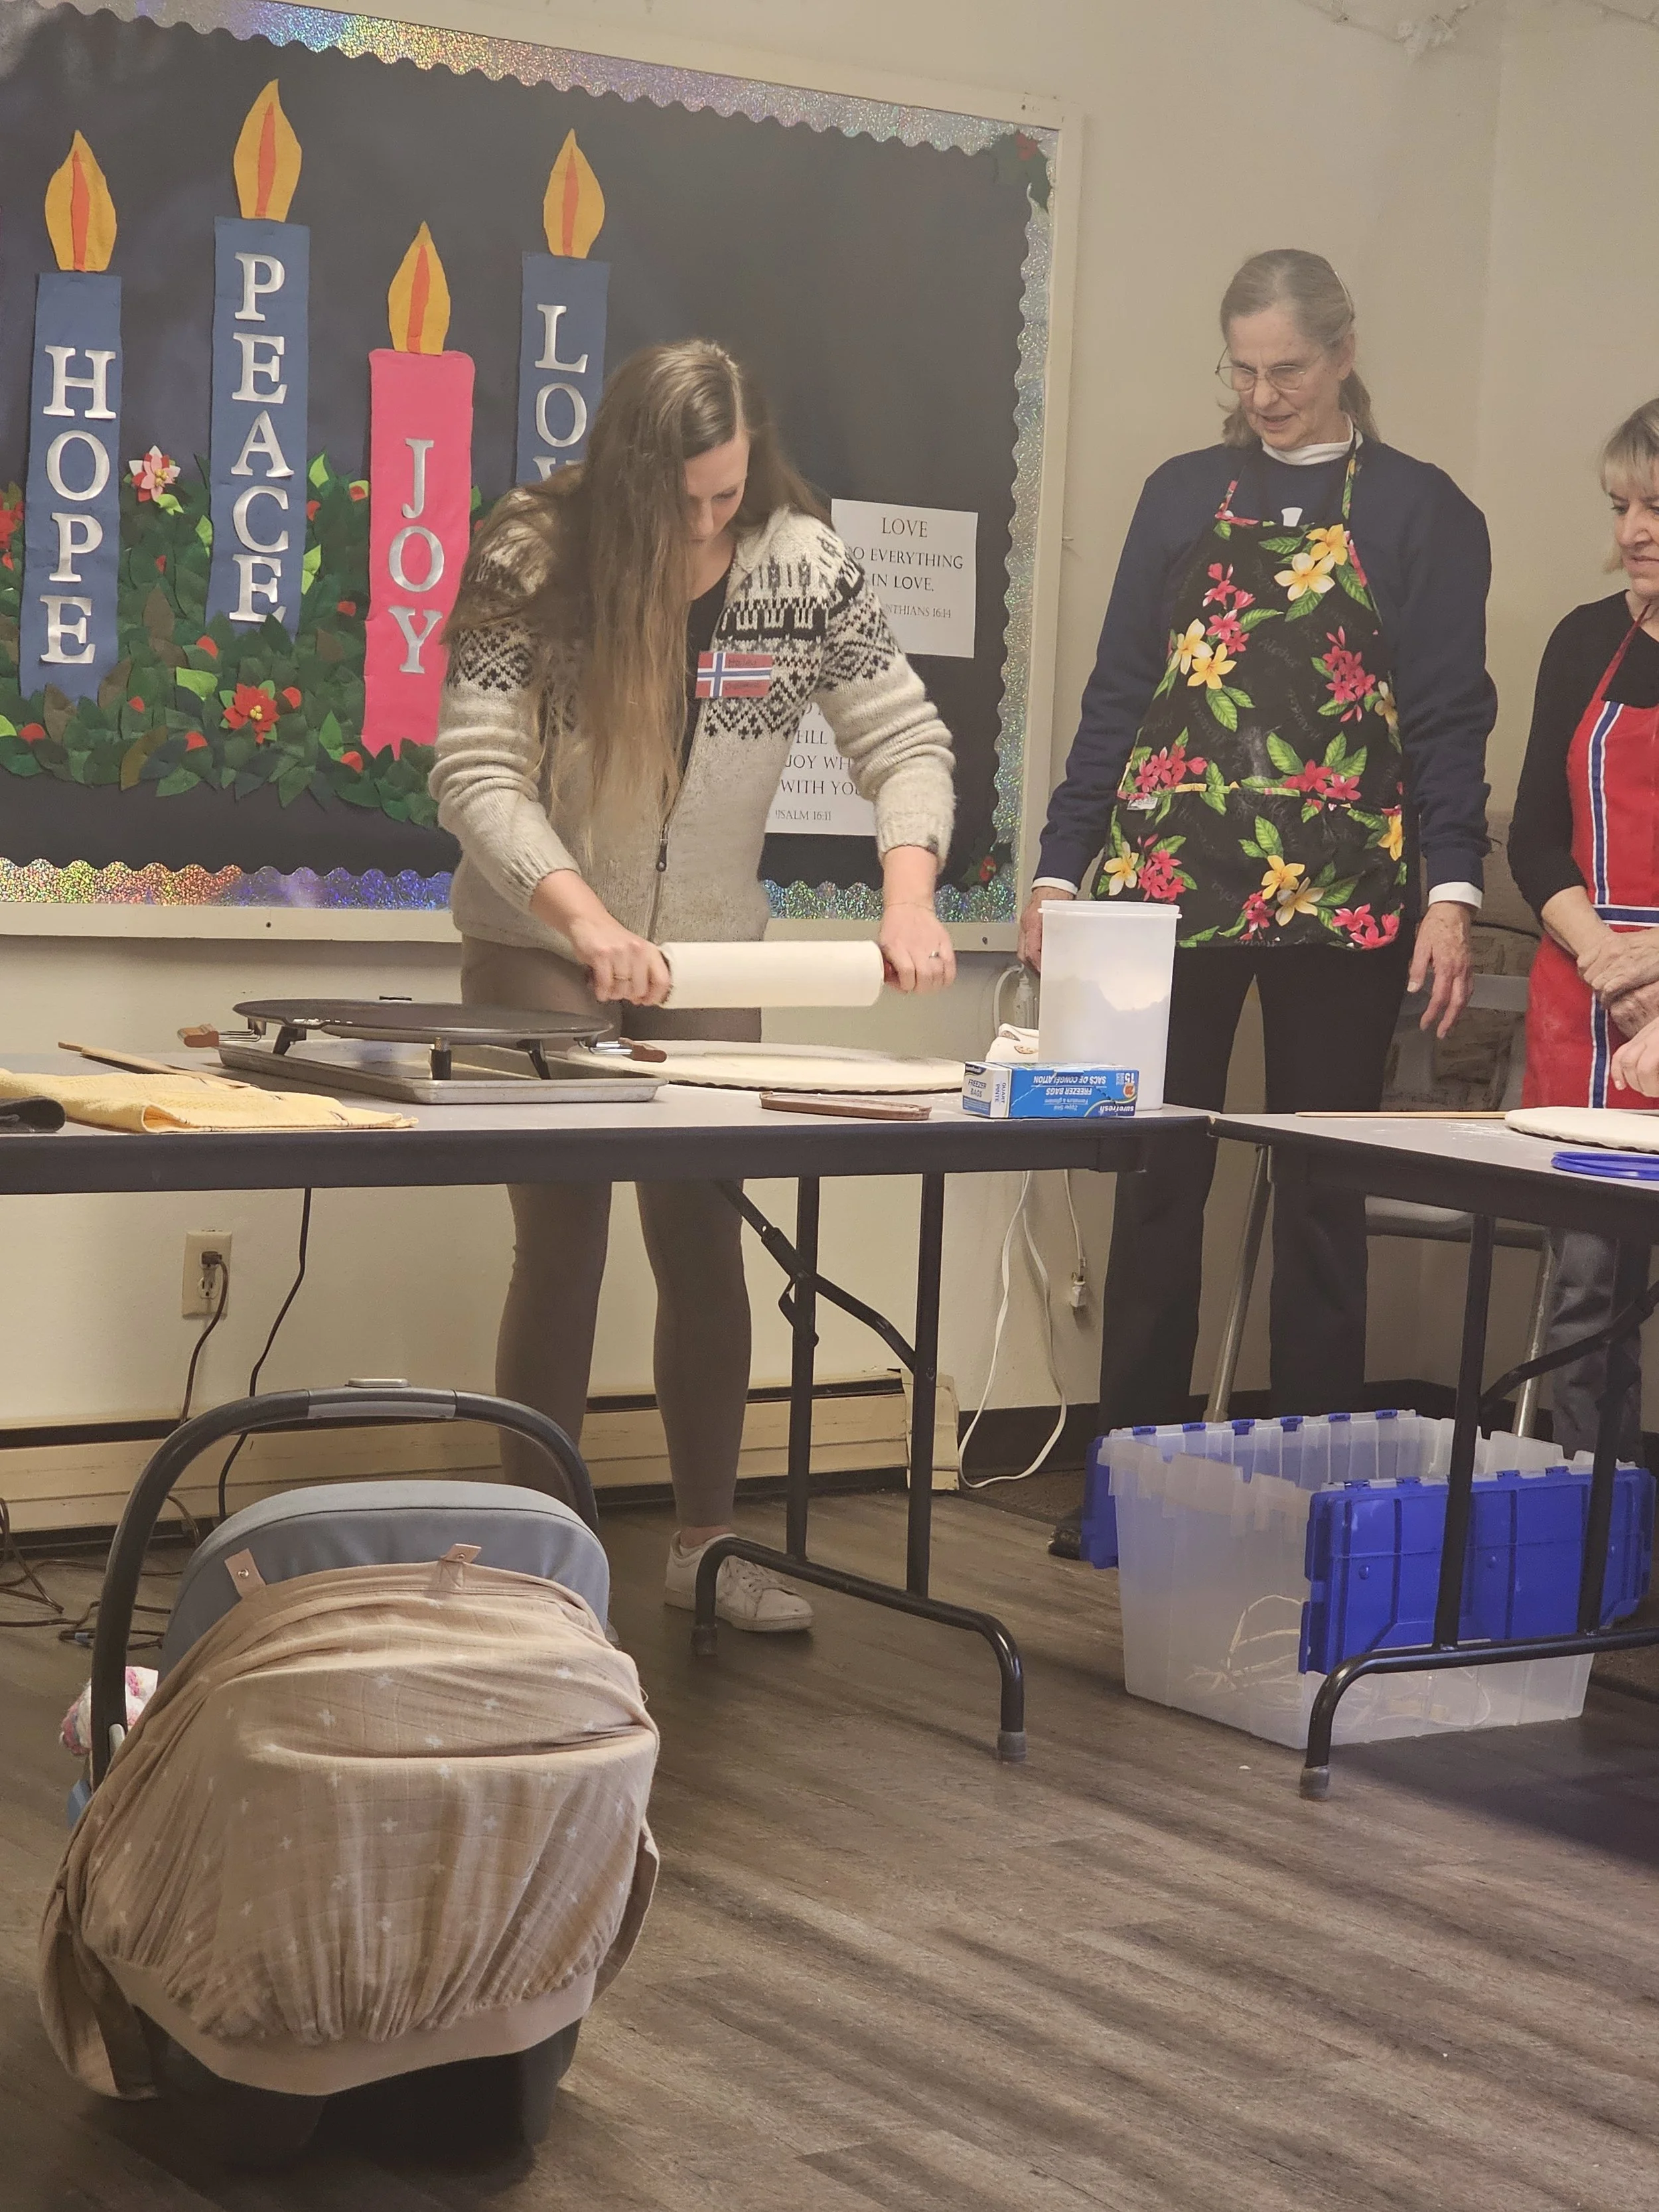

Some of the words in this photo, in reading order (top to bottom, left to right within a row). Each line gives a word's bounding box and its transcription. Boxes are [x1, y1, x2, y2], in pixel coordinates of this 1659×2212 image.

[229, 251, 294, 623] PEACE
[40, 344, 117, 664] HOPE
[881, 516, 928, 538] LOVE
[388, 437, 445, 674] JOY
[871, 548, 963, 569] EVERYTHING
[872, 573, 888, 587] IN
[894, 575, 934, 592] LOVE.
[932, 607, 952, 619] 16:14
[796, 729, 828, 745] FILL
[785, 754, 817, 769] JOY
[781, 779, 824, 794] WITH
[813, 810, 831, 821] 16:11
[968, 1078, 987, 1089] FREEZER
[1088, 1075, 1107, 1084] SACS
[1125, 1072, 1135, 1084] 15
[970, 1088, 983, 1098] BAGS
[1045, 1087, 1064, 1096] BAGS
[1065, 1087, 1092, 1096] FREEZER
